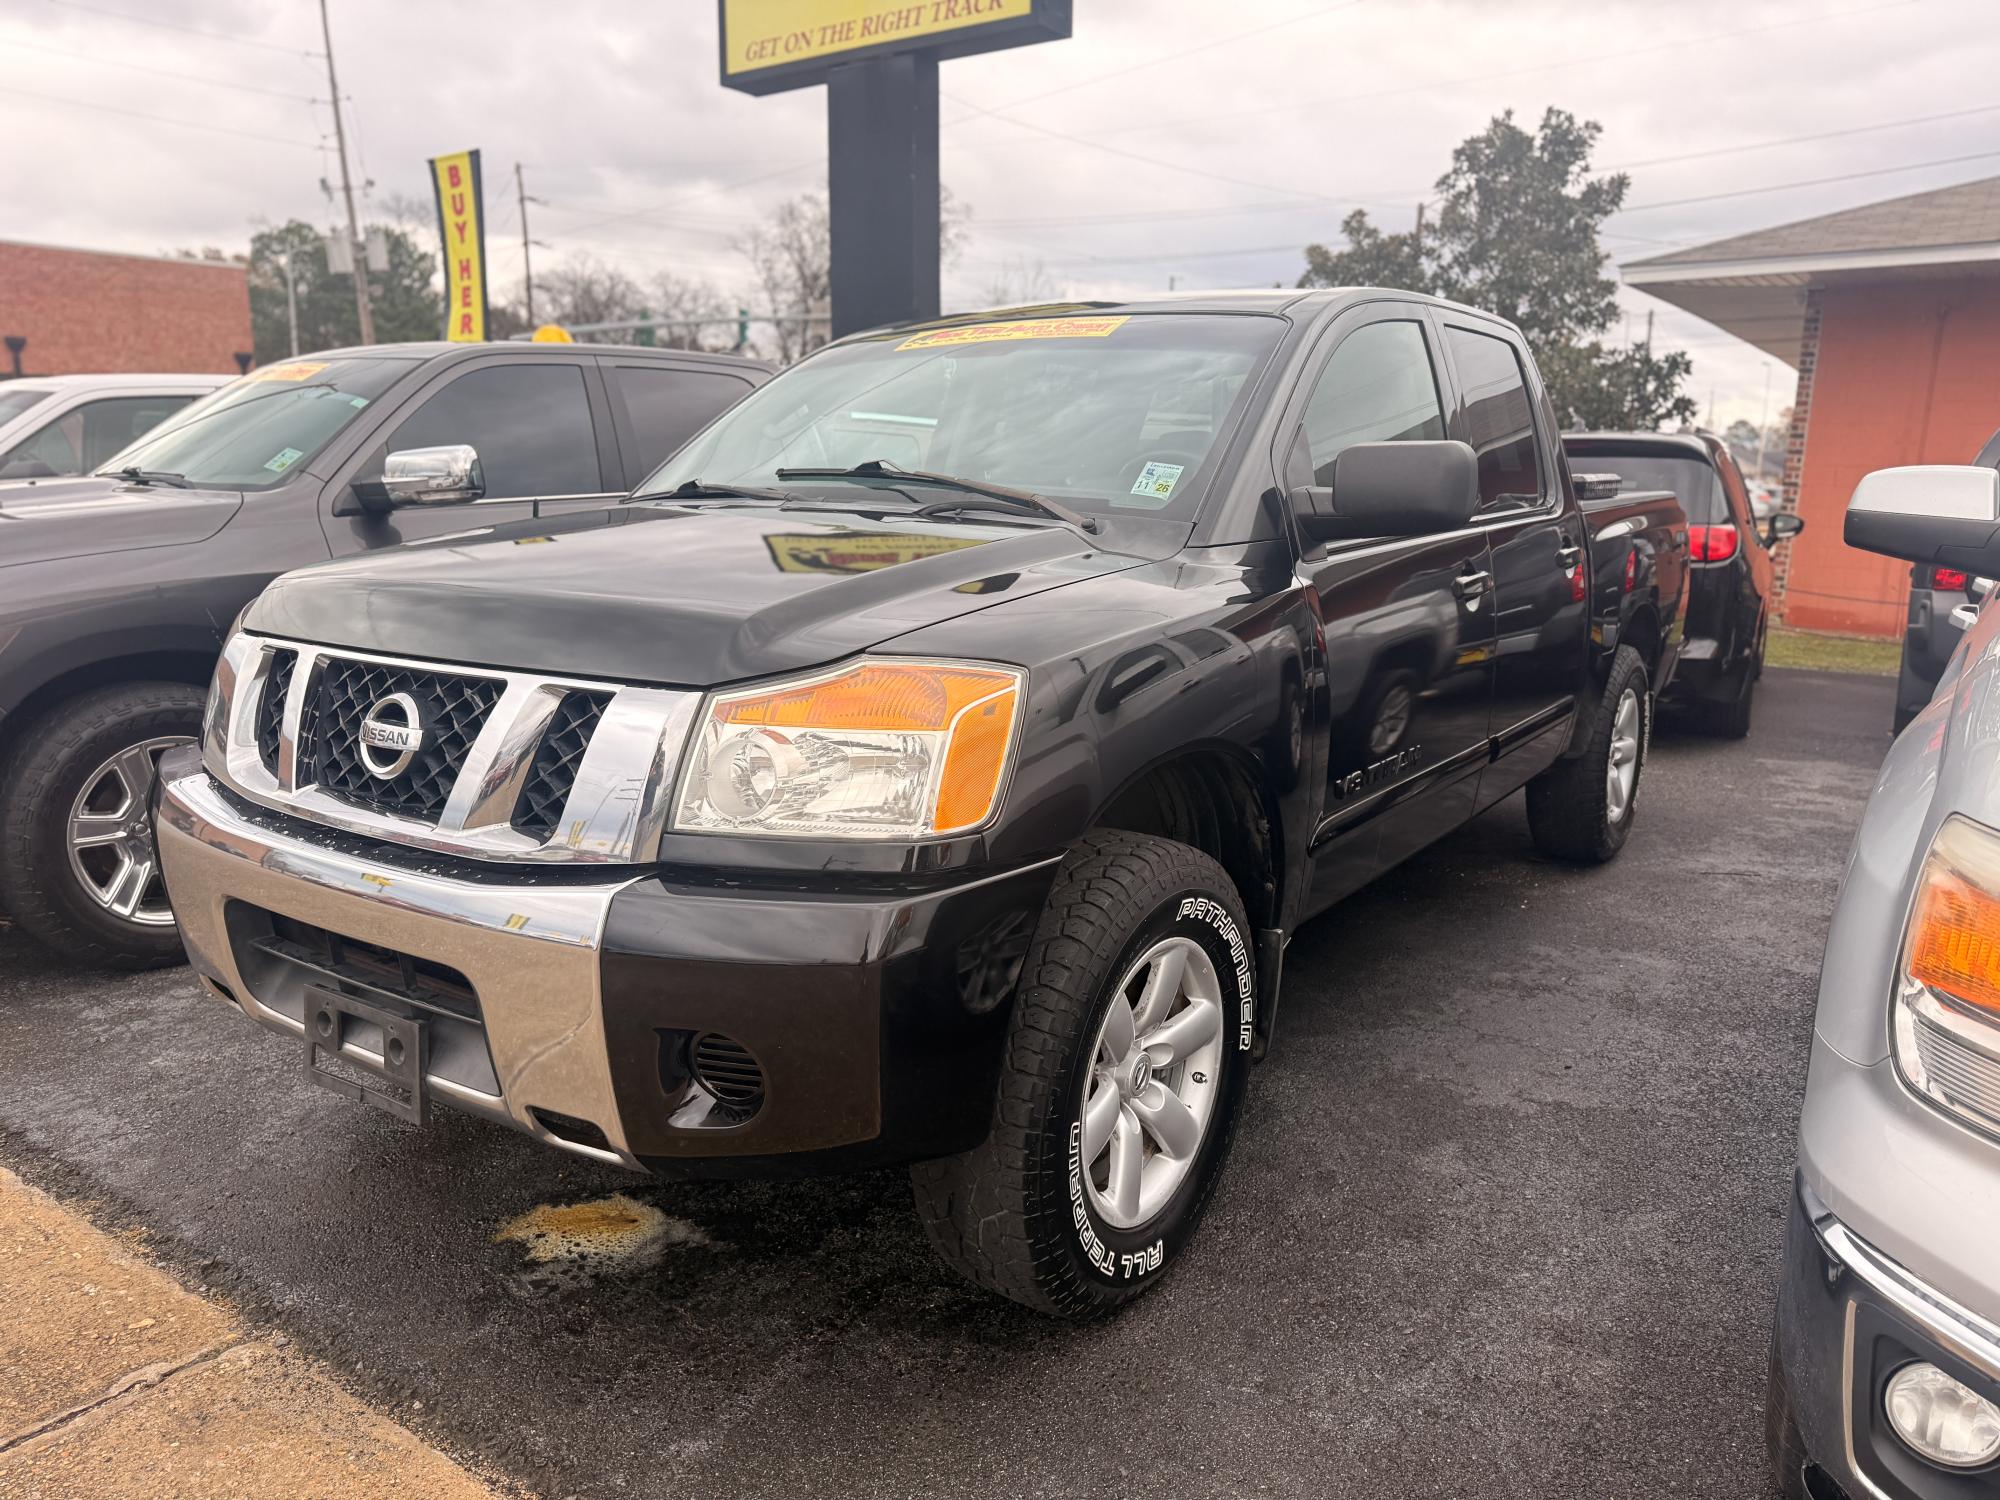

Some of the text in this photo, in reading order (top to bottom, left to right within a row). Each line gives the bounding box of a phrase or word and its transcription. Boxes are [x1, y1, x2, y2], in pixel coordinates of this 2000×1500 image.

[745, 35, 782, 61] GET
[784, 28, 814, 53] ON
[818, 19, 857, 47] THE
[860, 4, 926, 38] RIGHT
[448, 165, 467, 245] BUY
[1137, 481, 1170, 493] 11 26
[362, 721, 410, 746] NISSAN
[1176, 898, 1253, 1051] PATHFINDER
[1069, 1122, 1164, 1279] ALL TERRAIN
